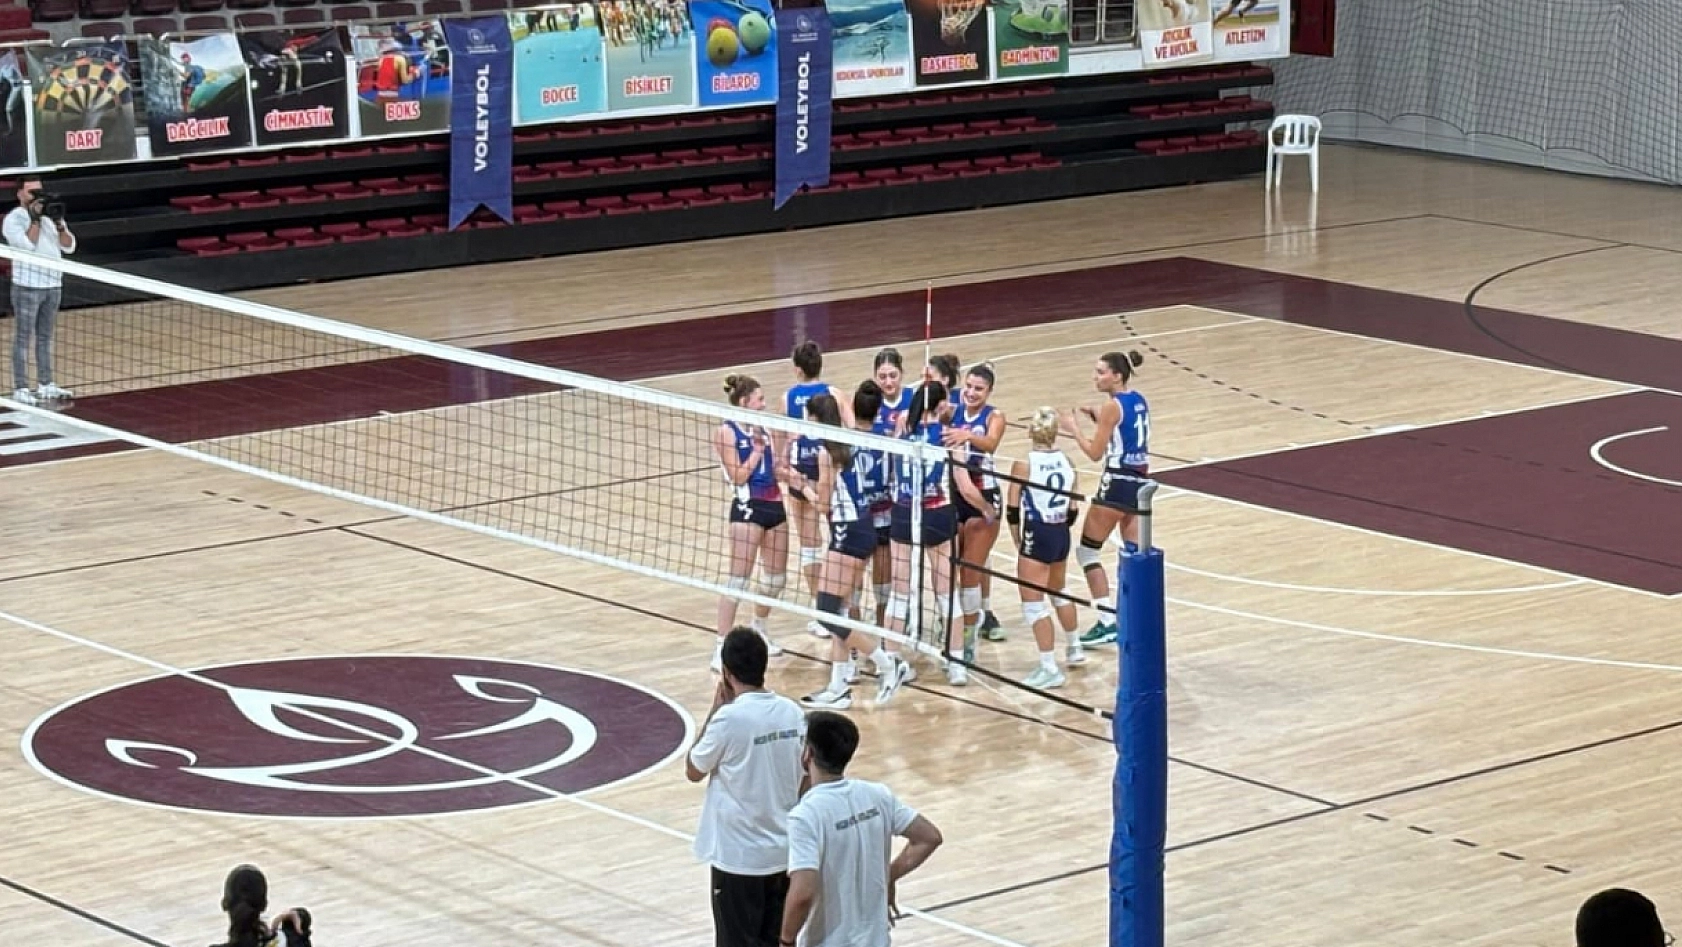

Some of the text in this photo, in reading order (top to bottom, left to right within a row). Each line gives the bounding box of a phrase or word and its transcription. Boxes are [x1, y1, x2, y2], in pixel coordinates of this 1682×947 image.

[624, 76, 672, 96] BİSİKLET
[713, 73, 760, 92] BİLARDO
[541, 85, 578, 106] BOCCE
[797, 51, 810, 154] VOLEYBOL
[385, 101, 420, 121] BOKS
[474, 64, 490, 172] VOLEYBOL
[66, 129, 103, 150] DART
[1047, 471, 1066, 509] 2
